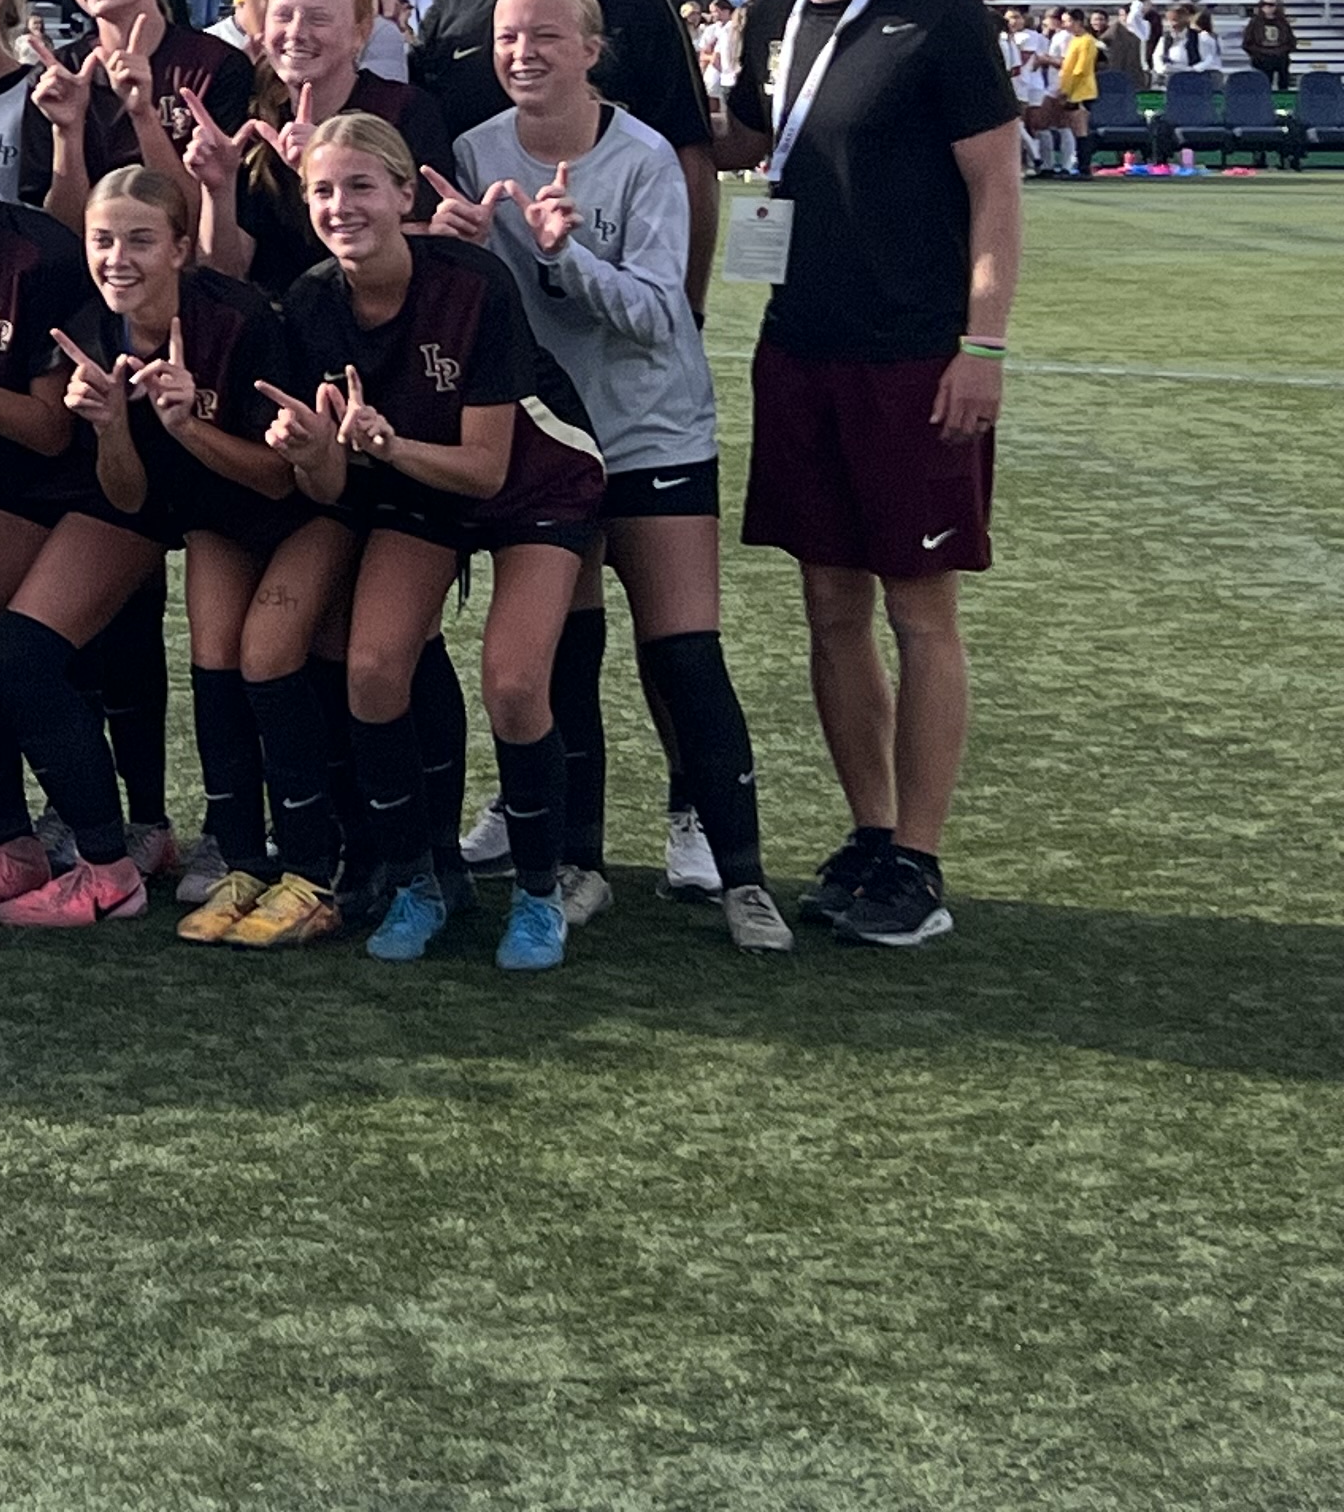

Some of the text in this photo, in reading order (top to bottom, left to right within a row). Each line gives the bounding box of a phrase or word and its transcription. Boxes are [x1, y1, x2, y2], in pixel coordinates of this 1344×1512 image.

[594, 208, 617, 242] LP
[419, 343, 460, 392] LP
[194, 389, 219, 420] P
